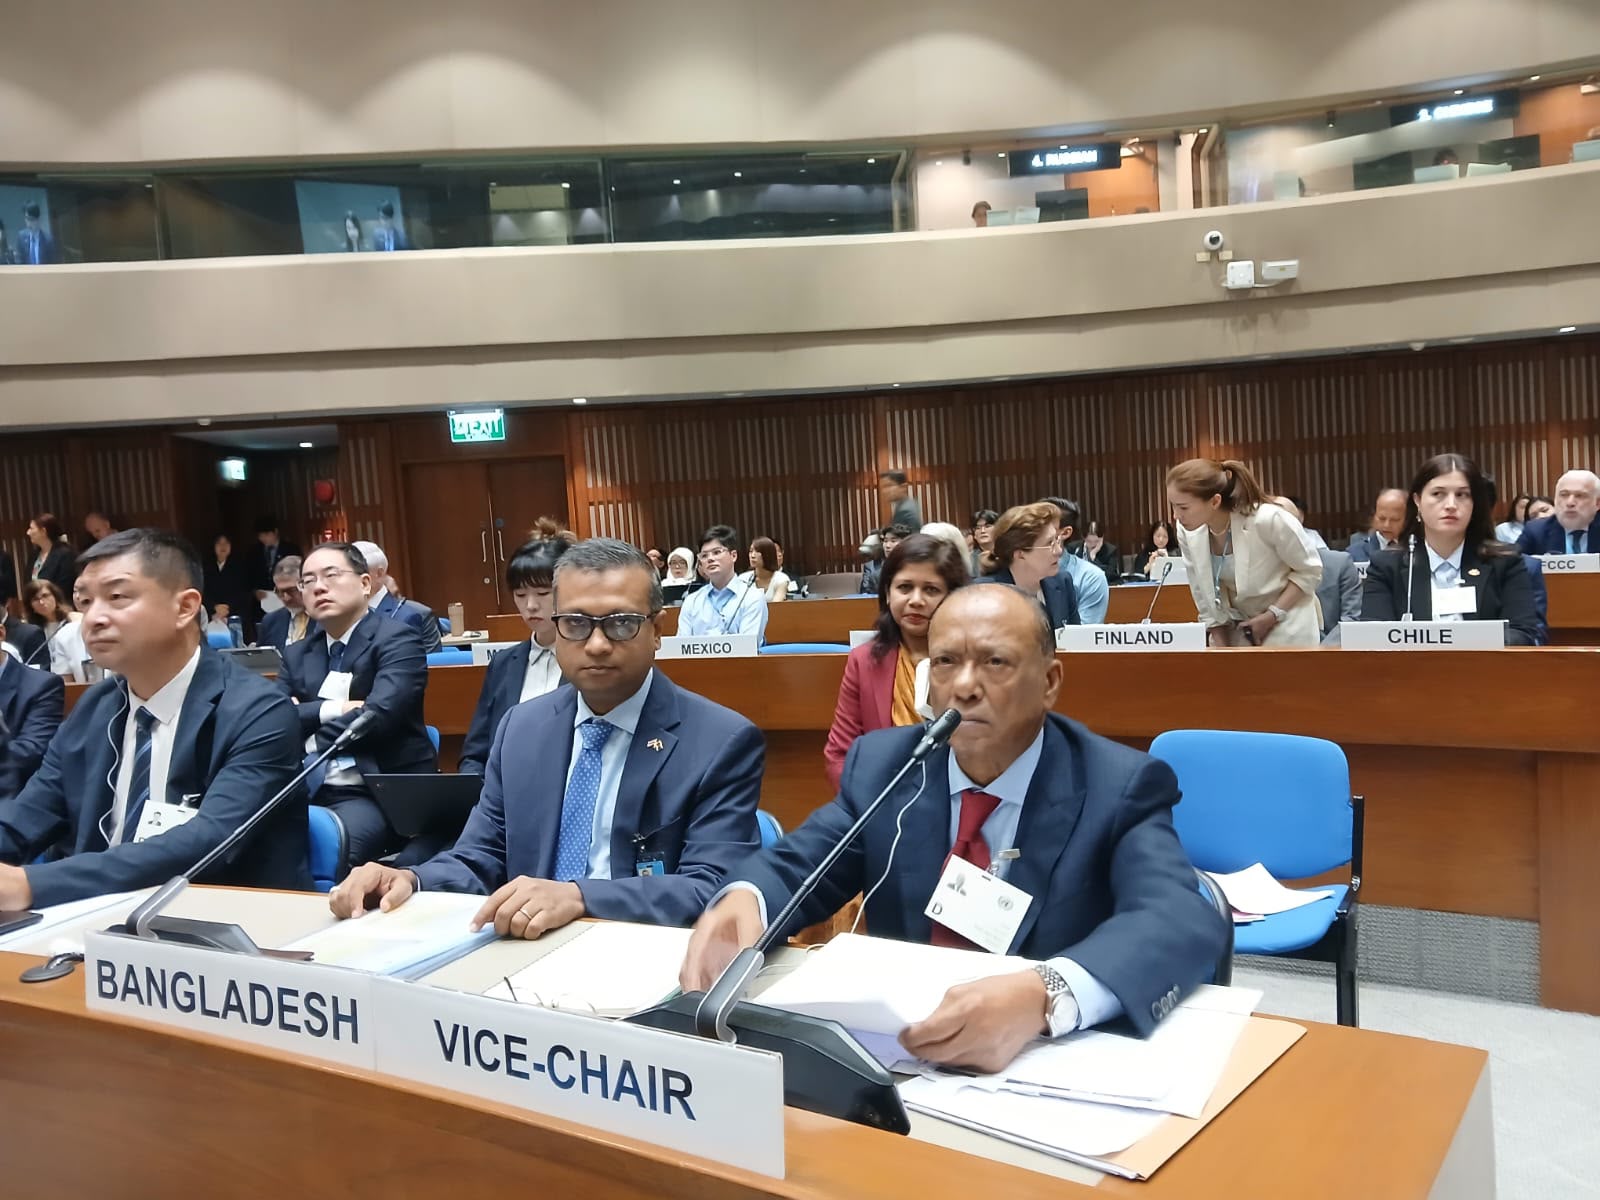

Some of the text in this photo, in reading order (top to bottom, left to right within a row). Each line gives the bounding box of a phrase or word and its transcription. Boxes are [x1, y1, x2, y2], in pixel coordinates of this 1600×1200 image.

[1094, 630, 1174, 645] FINLAND
[1387, 628, 1453, 644] CHILE
[681, 642, 732, 655] MEXICO
[931, 901, 943, 915] D
[97, 959, 359, 1044] BANGLADESH
[434, 1019, 697, 1121] VICE-CHAIR
